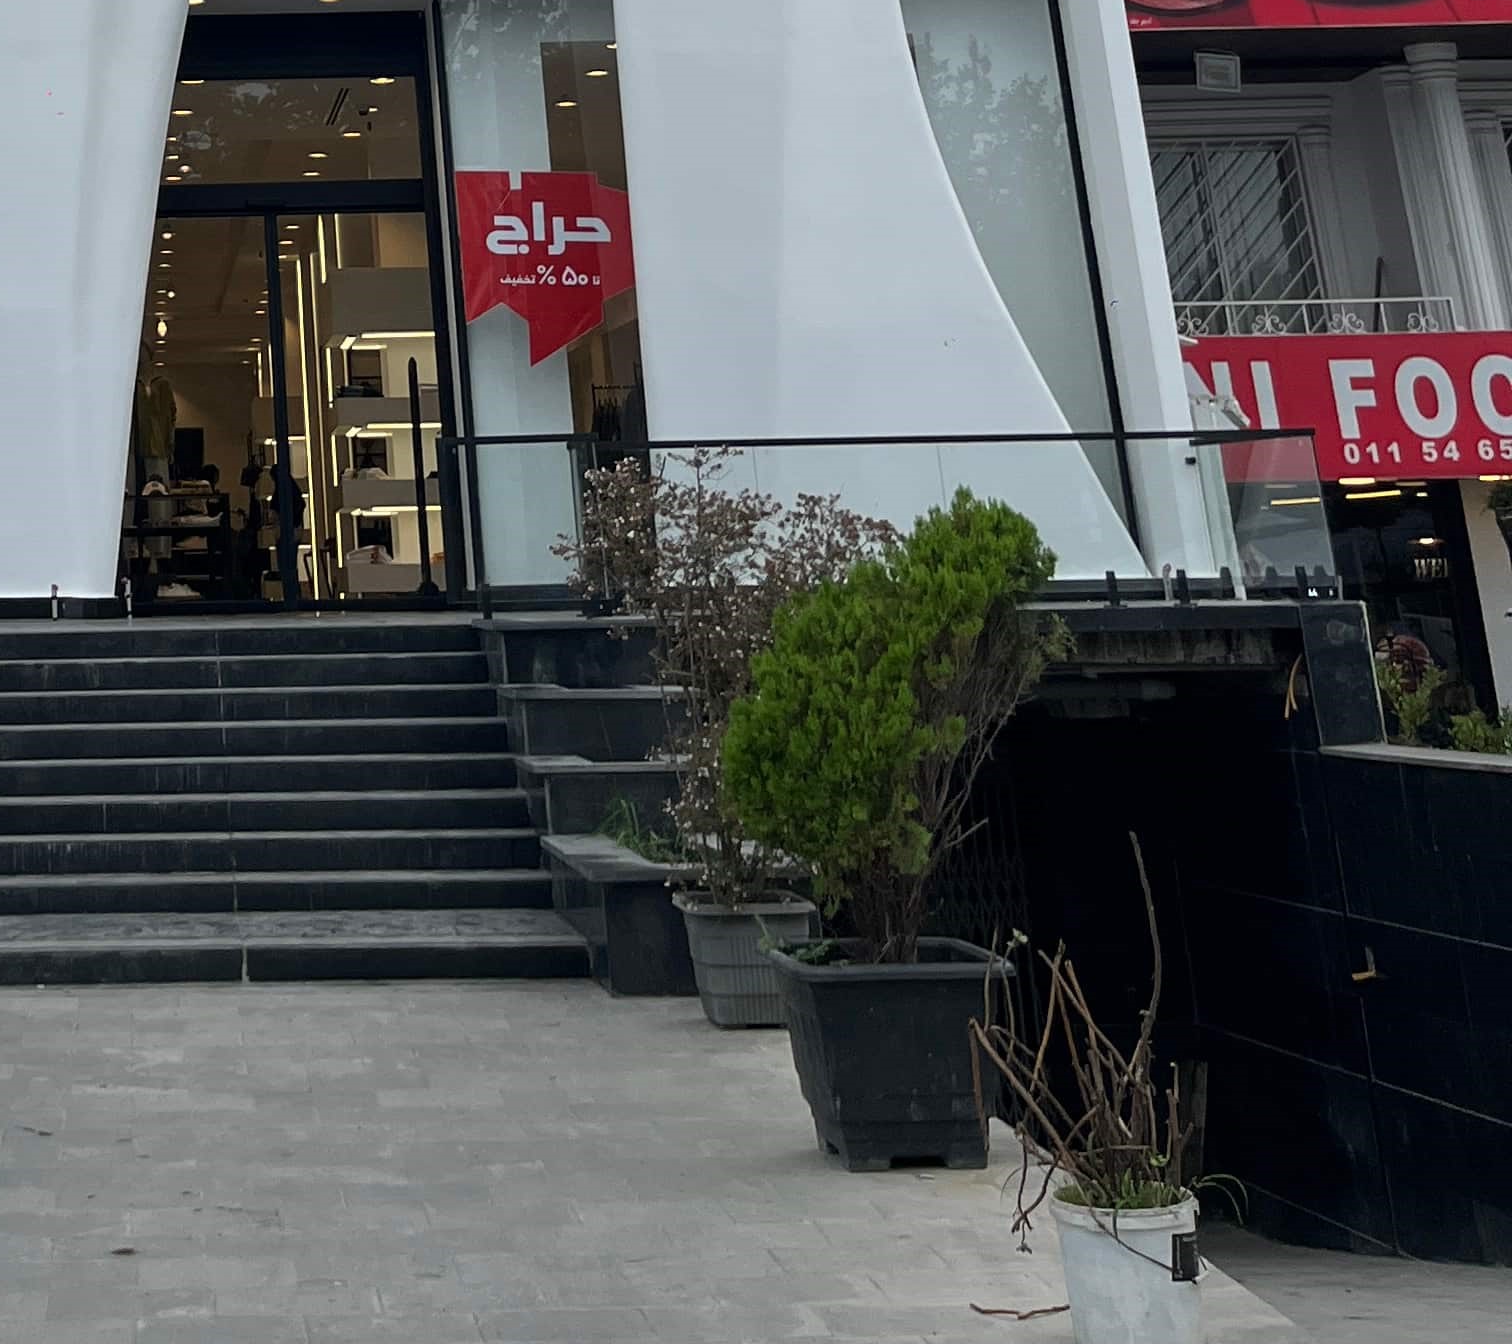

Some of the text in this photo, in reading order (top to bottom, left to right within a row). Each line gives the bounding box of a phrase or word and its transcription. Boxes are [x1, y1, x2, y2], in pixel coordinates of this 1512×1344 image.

[486, 201, 611, 255] حراج
[499, 274, 536, 286] تخفیف
[1343, 442, 1402, 465] 011
[1421, 439, 1461, 463] 54
